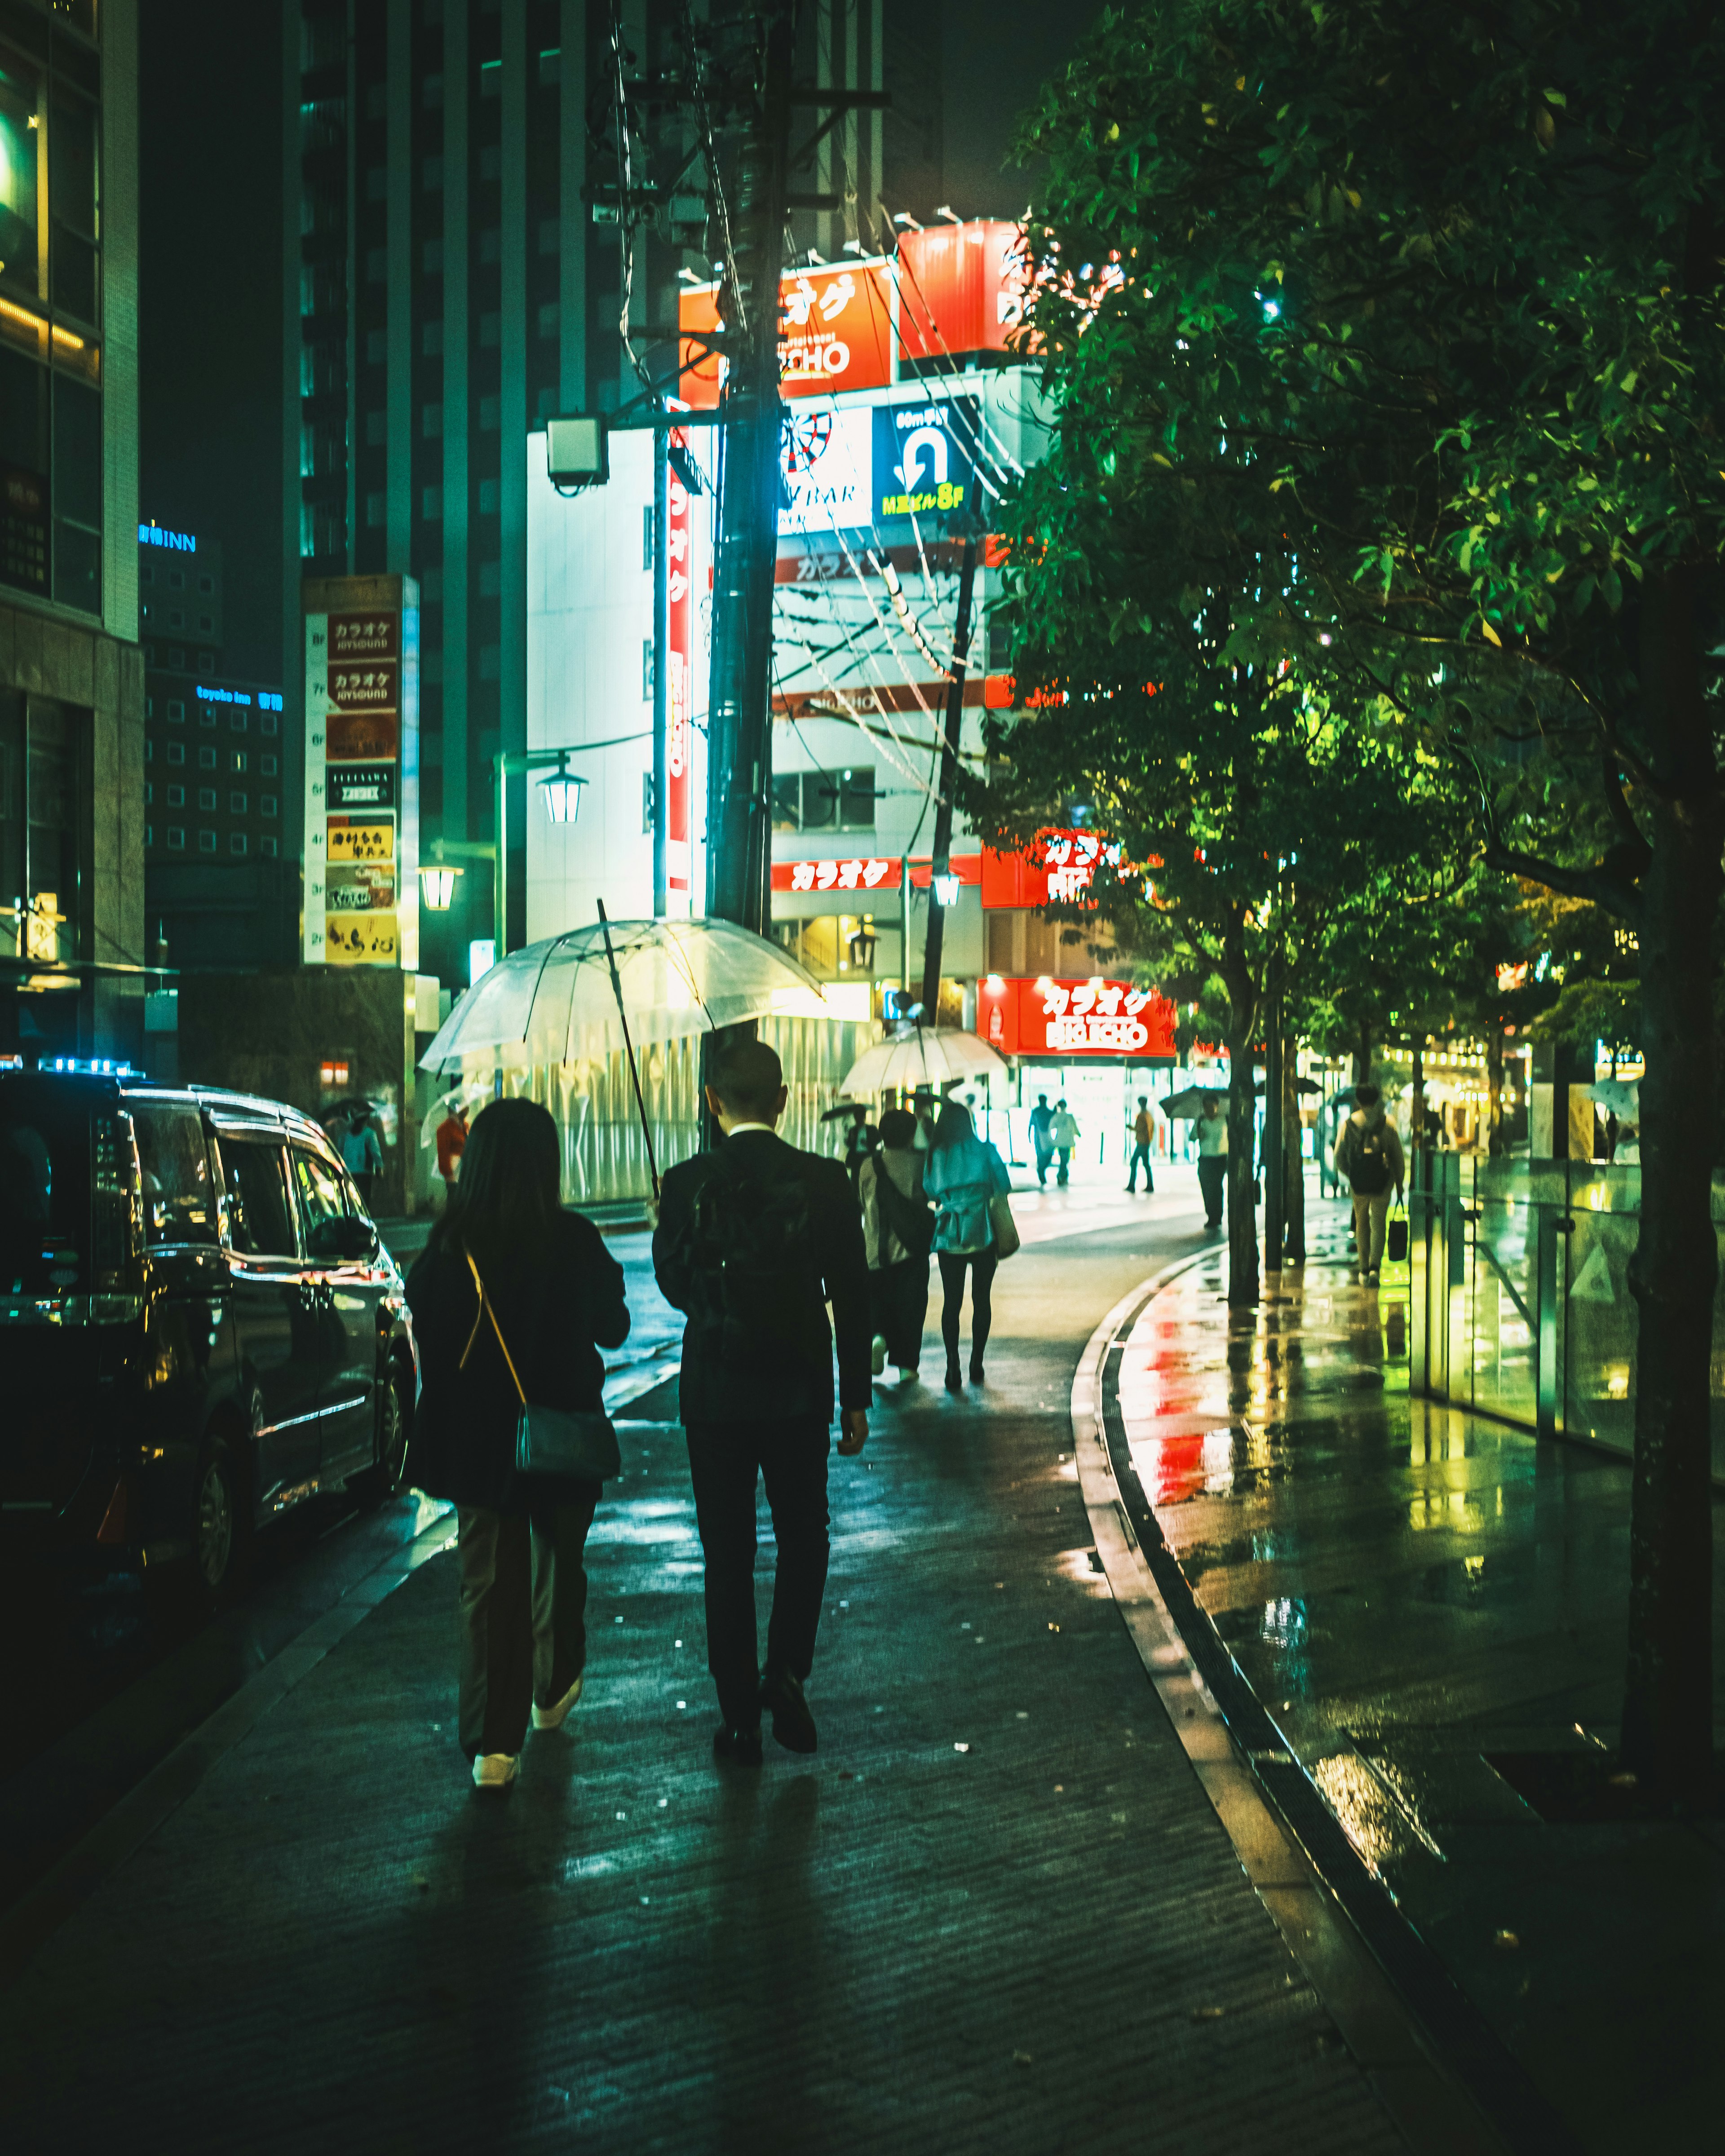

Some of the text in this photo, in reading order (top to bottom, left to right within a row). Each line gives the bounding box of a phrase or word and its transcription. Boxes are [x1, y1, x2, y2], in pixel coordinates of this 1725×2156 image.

[670, 438, 688, 602] ラオケ
[336, 622, 390, 638] カラオケ
[336, 672, 390, 689] カラオケ
[196, 685, 233, 703] toyoko
[338, 689, 388, 701] JOYSOUND
[792, 859, 889, 890] カラオケ
[1043, 985, 1152, 1016] カラオケ
